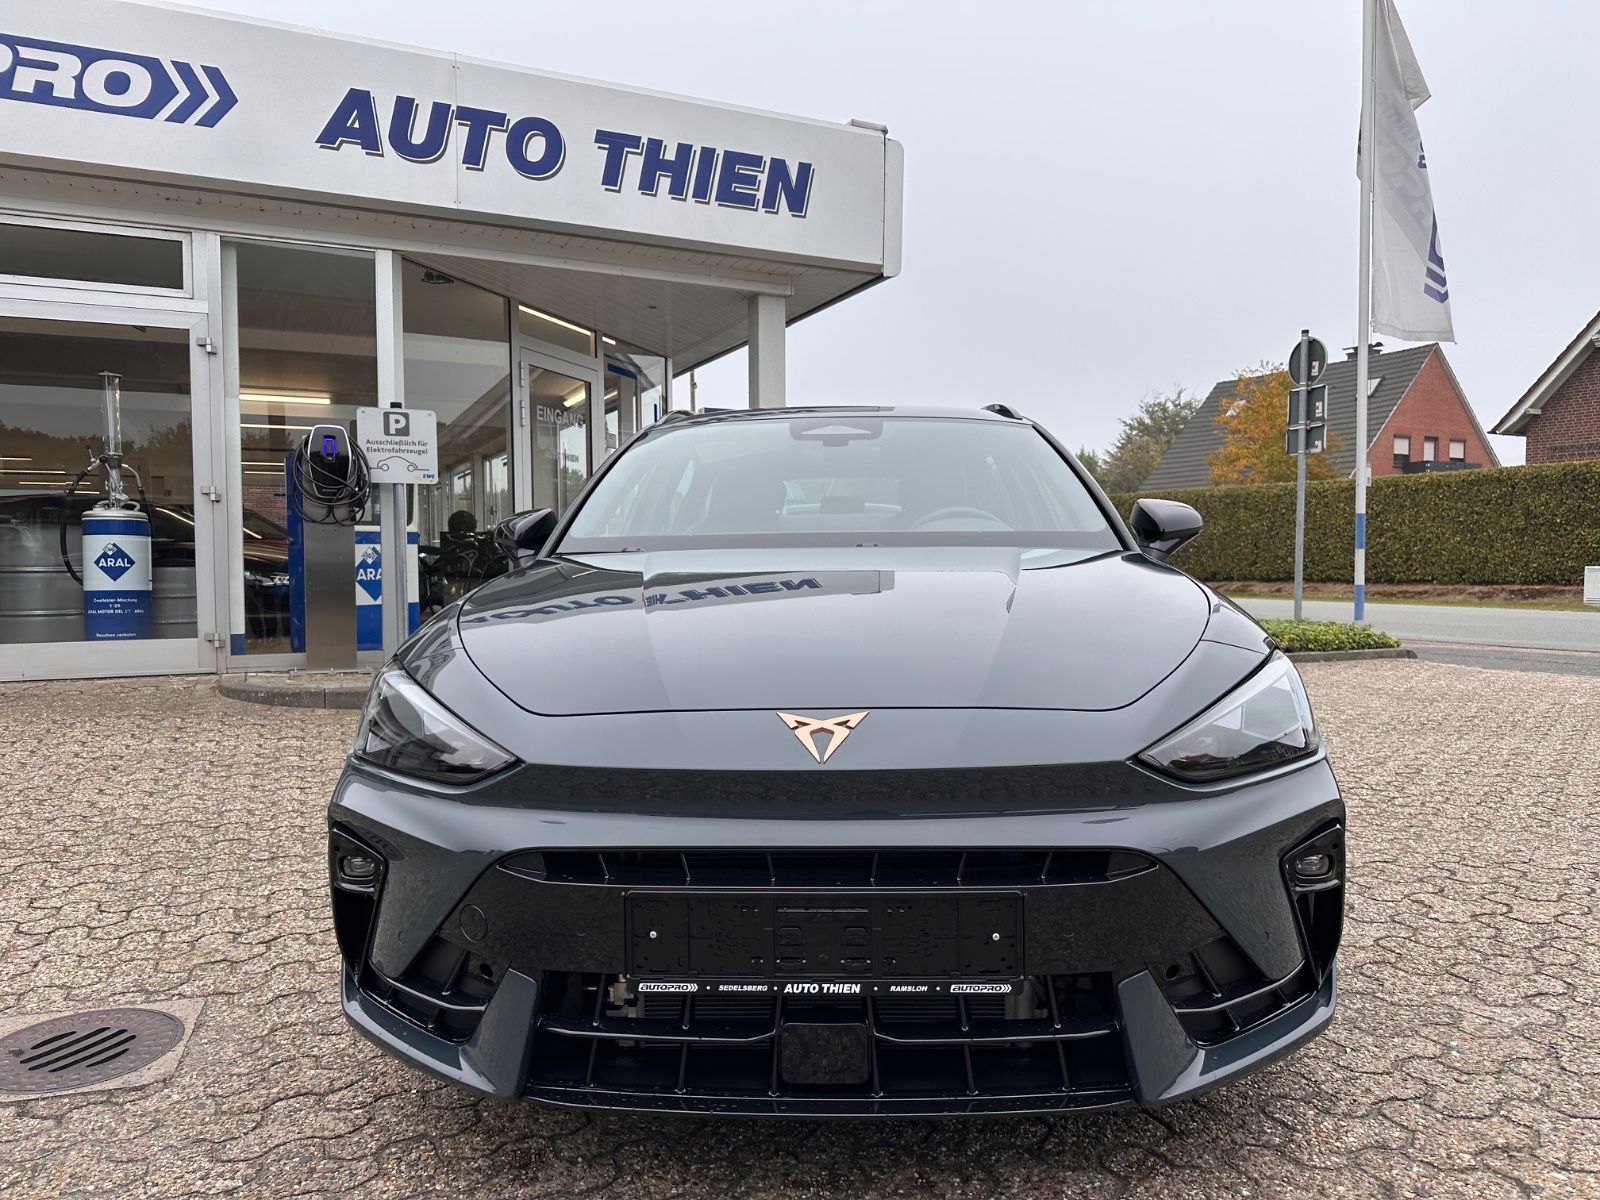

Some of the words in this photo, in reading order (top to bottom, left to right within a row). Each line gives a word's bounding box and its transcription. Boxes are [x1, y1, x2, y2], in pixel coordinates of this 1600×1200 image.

[0, 43, 152, 108] RO
[315, 87, 566, 181] AUTO
[594, 128, 816, 220] THIEN
[389, 413, 407, 434] P
[536, 405, 584, 429] EINGANG
[366, 439, 416, 447] Ausschließlich
[98, 558, 131, 568] ARAL
[357, 568, 382, 581] ARA
[718, 984, 768, 992] SEDELSBERG
[783, 983, 819, 994] AUTO
[822, 983, 861, 994] THIEN
